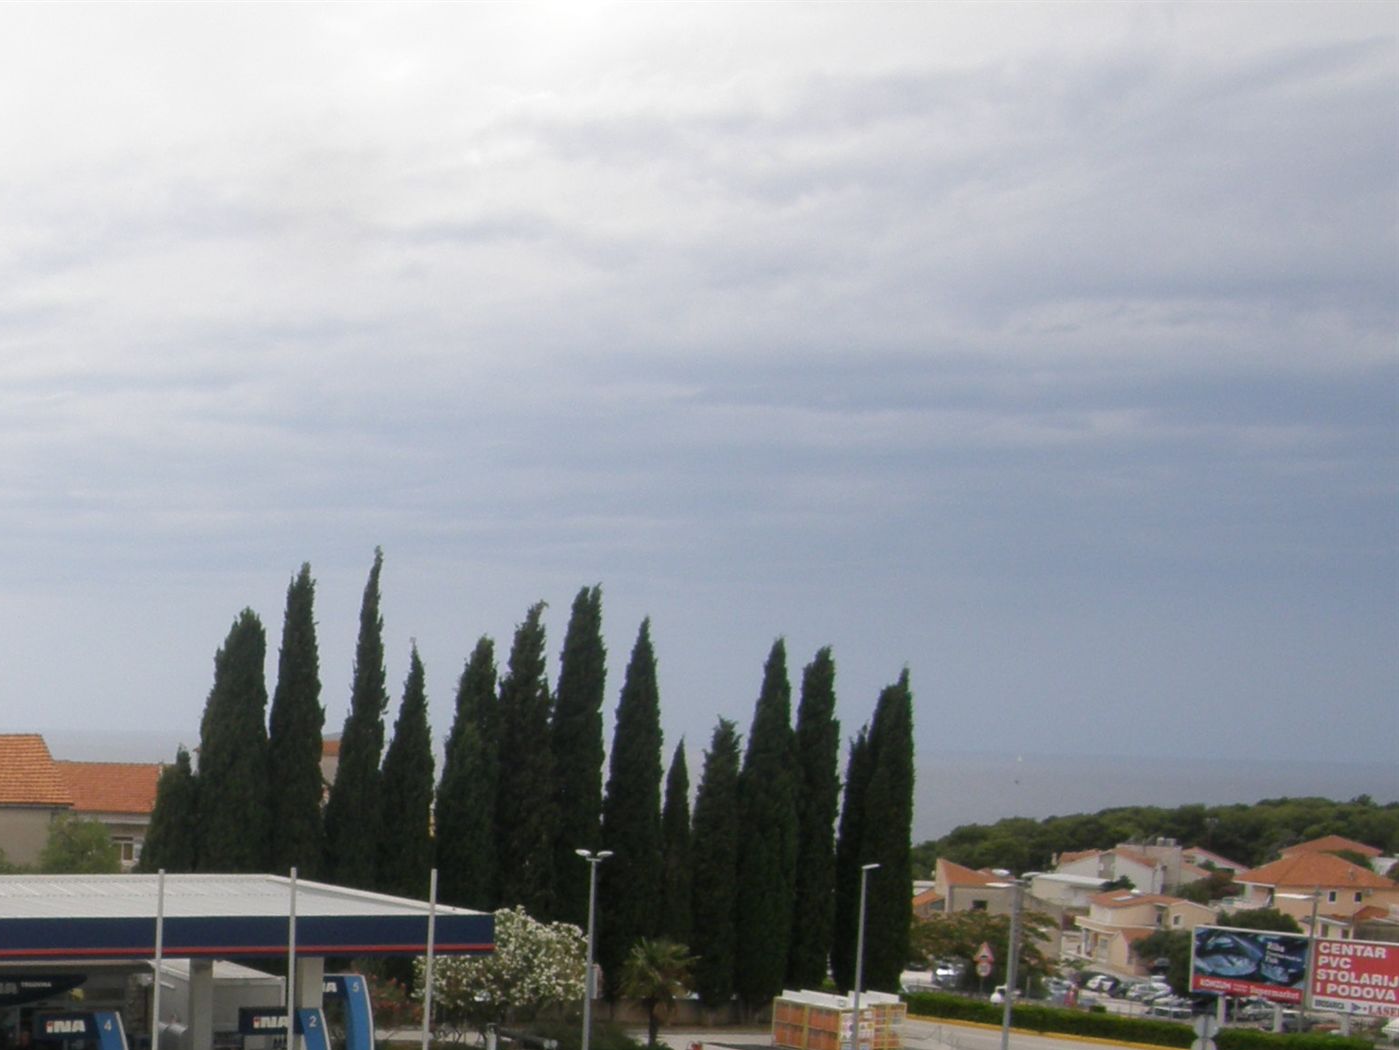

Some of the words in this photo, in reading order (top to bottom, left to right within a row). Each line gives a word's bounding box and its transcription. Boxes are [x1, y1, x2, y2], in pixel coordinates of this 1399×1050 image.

[1319, 942, 1386, 959] CENTAR
[1318, 955, 1352, 969] PVC
[352, 982, 359, 992] 5
[1250, 985, 1299, 999] Supermarket
[1316, 981, 1321, 993] I
[1326, 983, 1397, 1002] PODOVA
[46, 1020, 85, 1033] INA
[103, 1019, 112, 1031] 4
[308, 1015, 318, 1028] 2
